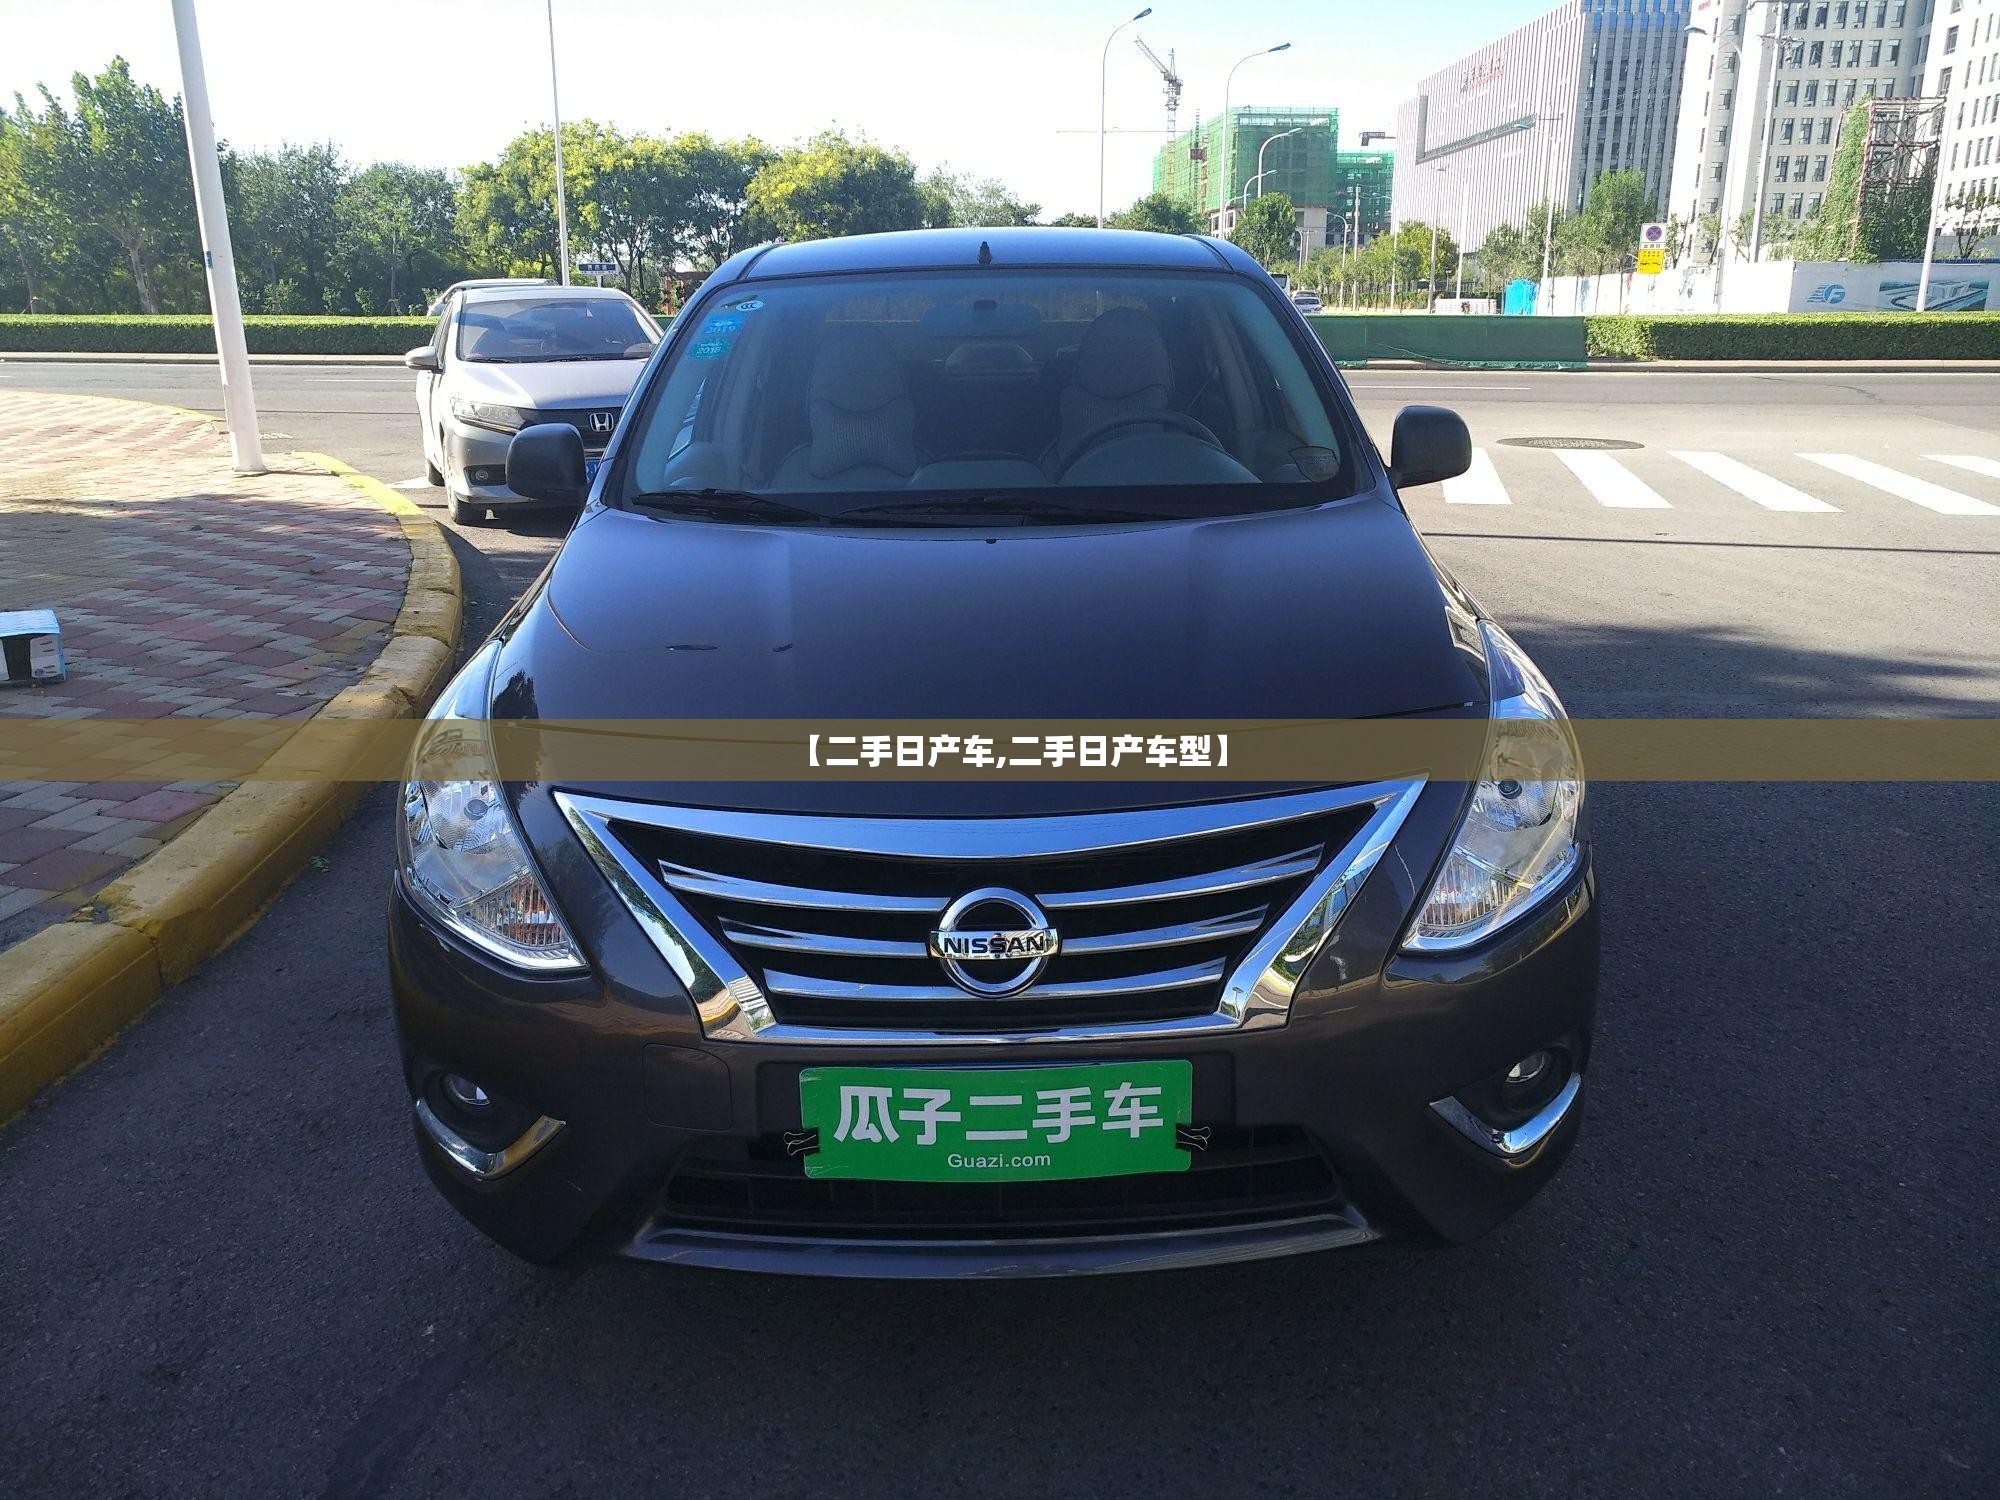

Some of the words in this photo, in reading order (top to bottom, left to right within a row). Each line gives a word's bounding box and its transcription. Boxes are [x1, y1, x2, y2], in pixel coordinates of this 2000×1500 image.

[943, 935, 1044, 954] NISSAN
[833, 1082, 1164, 1146] 瓜子二手车
[947, 1153, 1052, 1169] Guazi.com
